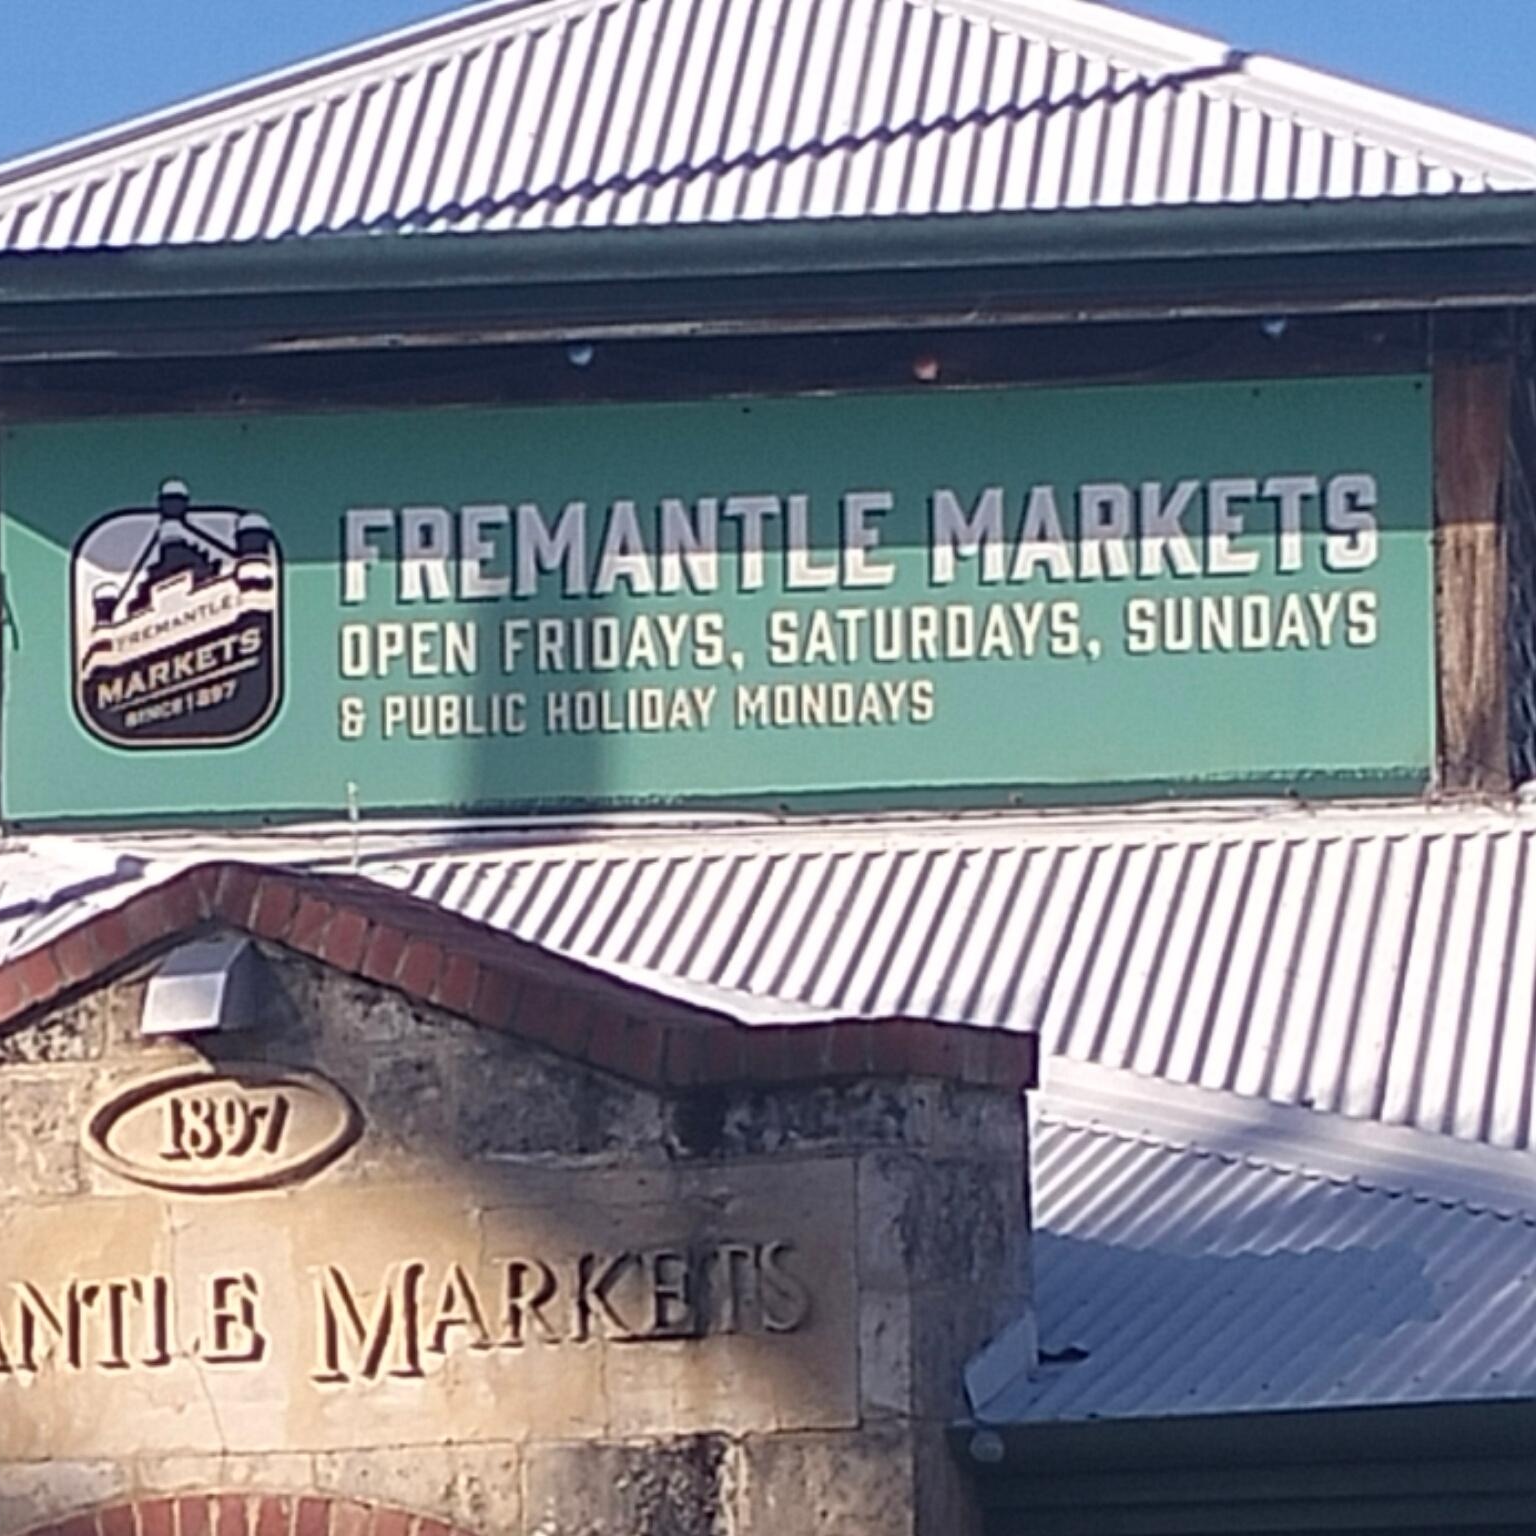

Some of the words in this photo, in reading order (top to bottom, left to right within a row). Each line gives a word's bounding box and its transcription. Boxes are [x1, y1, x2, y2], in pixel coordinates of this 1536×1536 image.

[342, 490, 895, 603] FREMANTLE
[929, 473, 1378, 585] MARKETS
[116, 595, 233, 648] FREMANTLE
[340, 621, 478, 678] OPEN
[503, 611, 745, 673] FRIDAYS,
[768, 600, 1101, 665] SATURDAYS,
[1125, 590, 1378, 653] SUNDAYS
[97, 627, 263, 709] MARKETS
[340, 696, 366, 739] &
[382, 693, 527, 738] PUBLIC
[548, 686, 716, 734] HOLIDAY
[736, 679, 935, 727] MONDAYS
[160, 1093, 290, 1161] 1897
[308, 1239, 814, 1385] MARKETS
